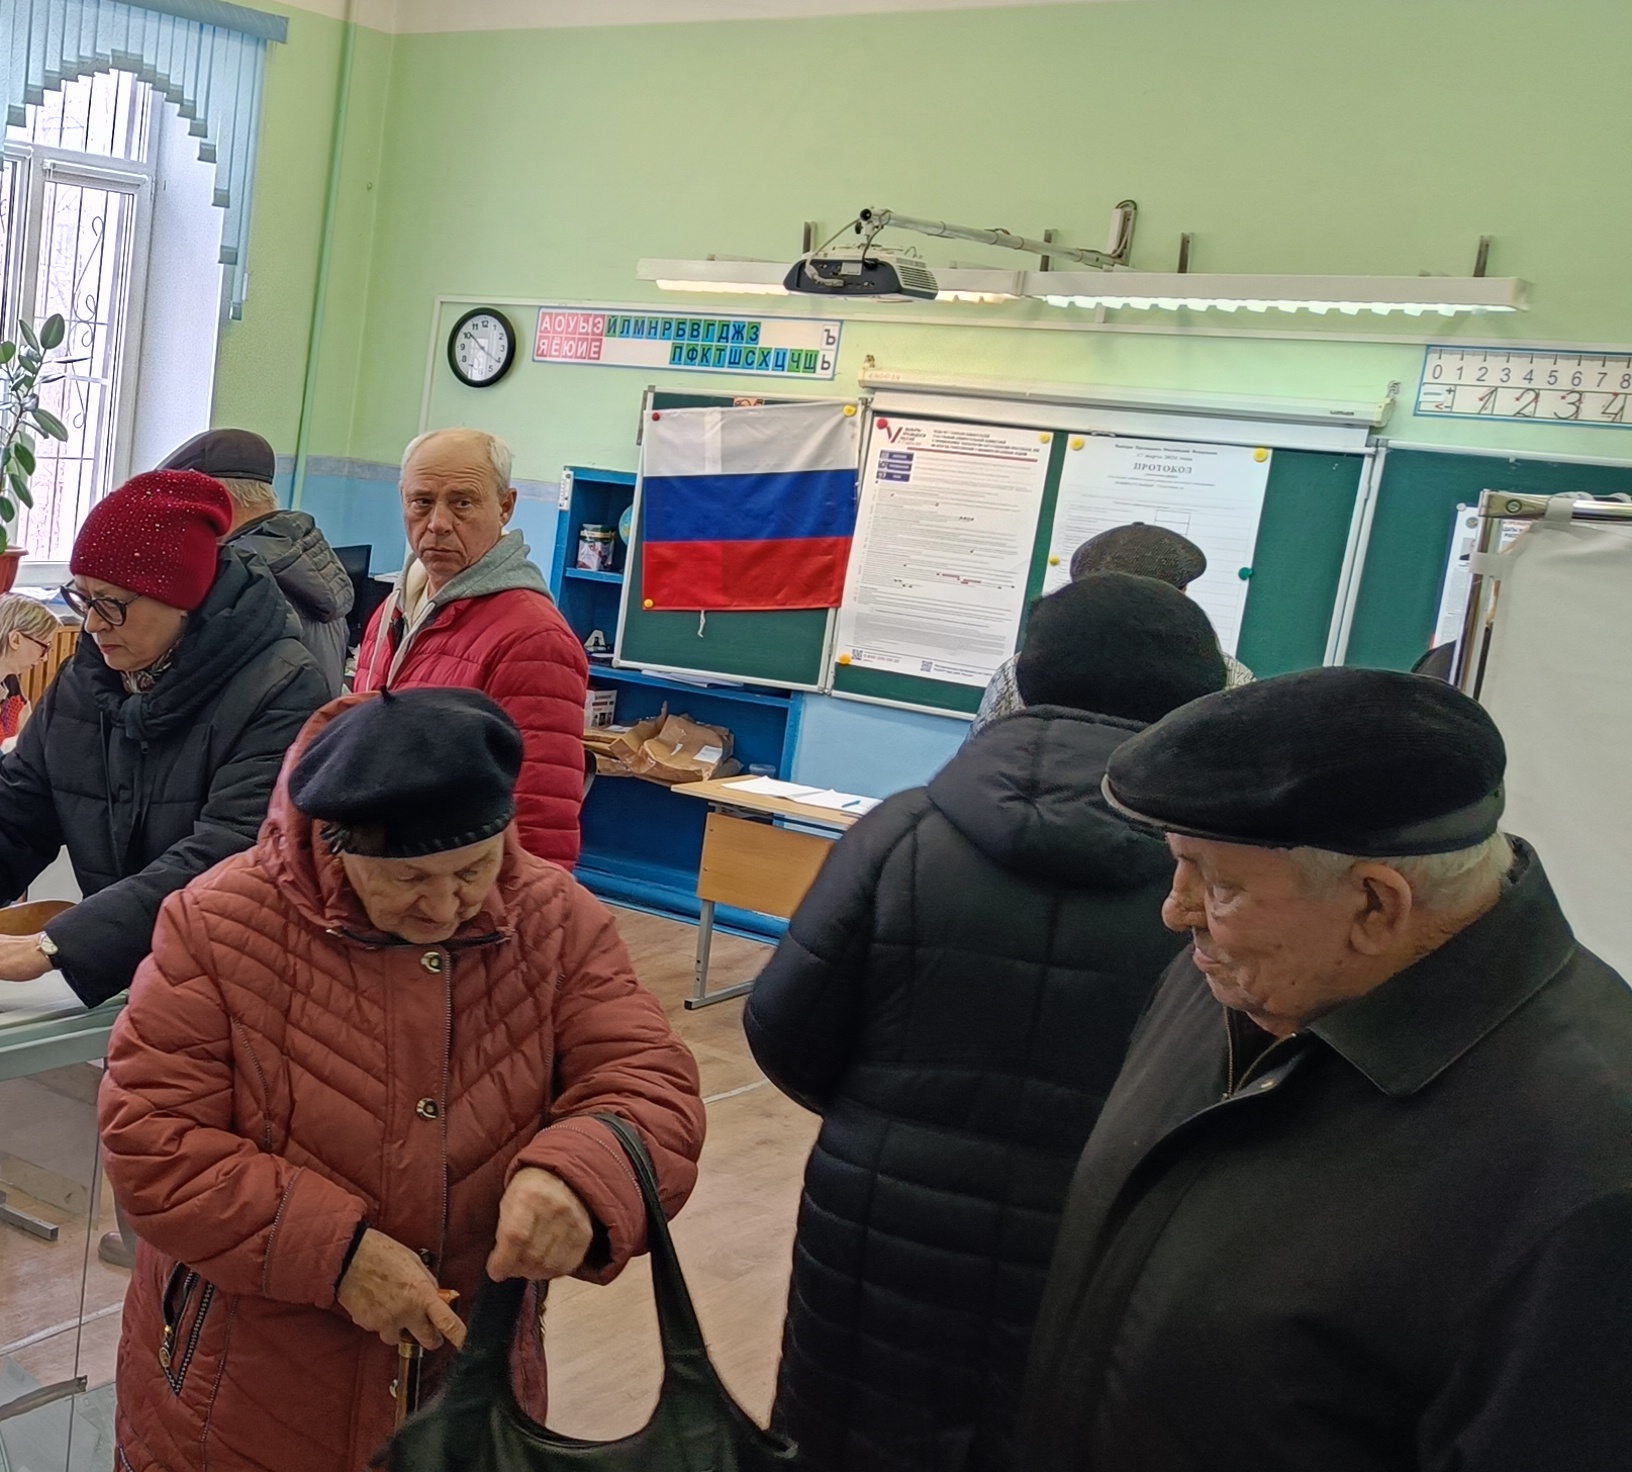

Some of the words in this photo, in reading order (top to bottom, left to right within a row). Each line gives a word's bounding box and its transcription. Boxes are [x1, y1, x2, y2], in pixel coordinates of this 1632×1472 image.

[1432, 364, 1443, 380] 0
[1456, 366, 1464, 380] 1
[1476, 366, 1489, 382] 2
[1500, 367, 1511, 383] 3
[1523, 369, 1534, 384] 4
[1546, 370, 1559, 385] 5
[1571, 371, 1583, 387] 6
[1597, 372, 1608, 387] 7
[1620, 373, 1632, 389] 8
[1132, 462, 1193, 474] ПРОТОКОЛ
